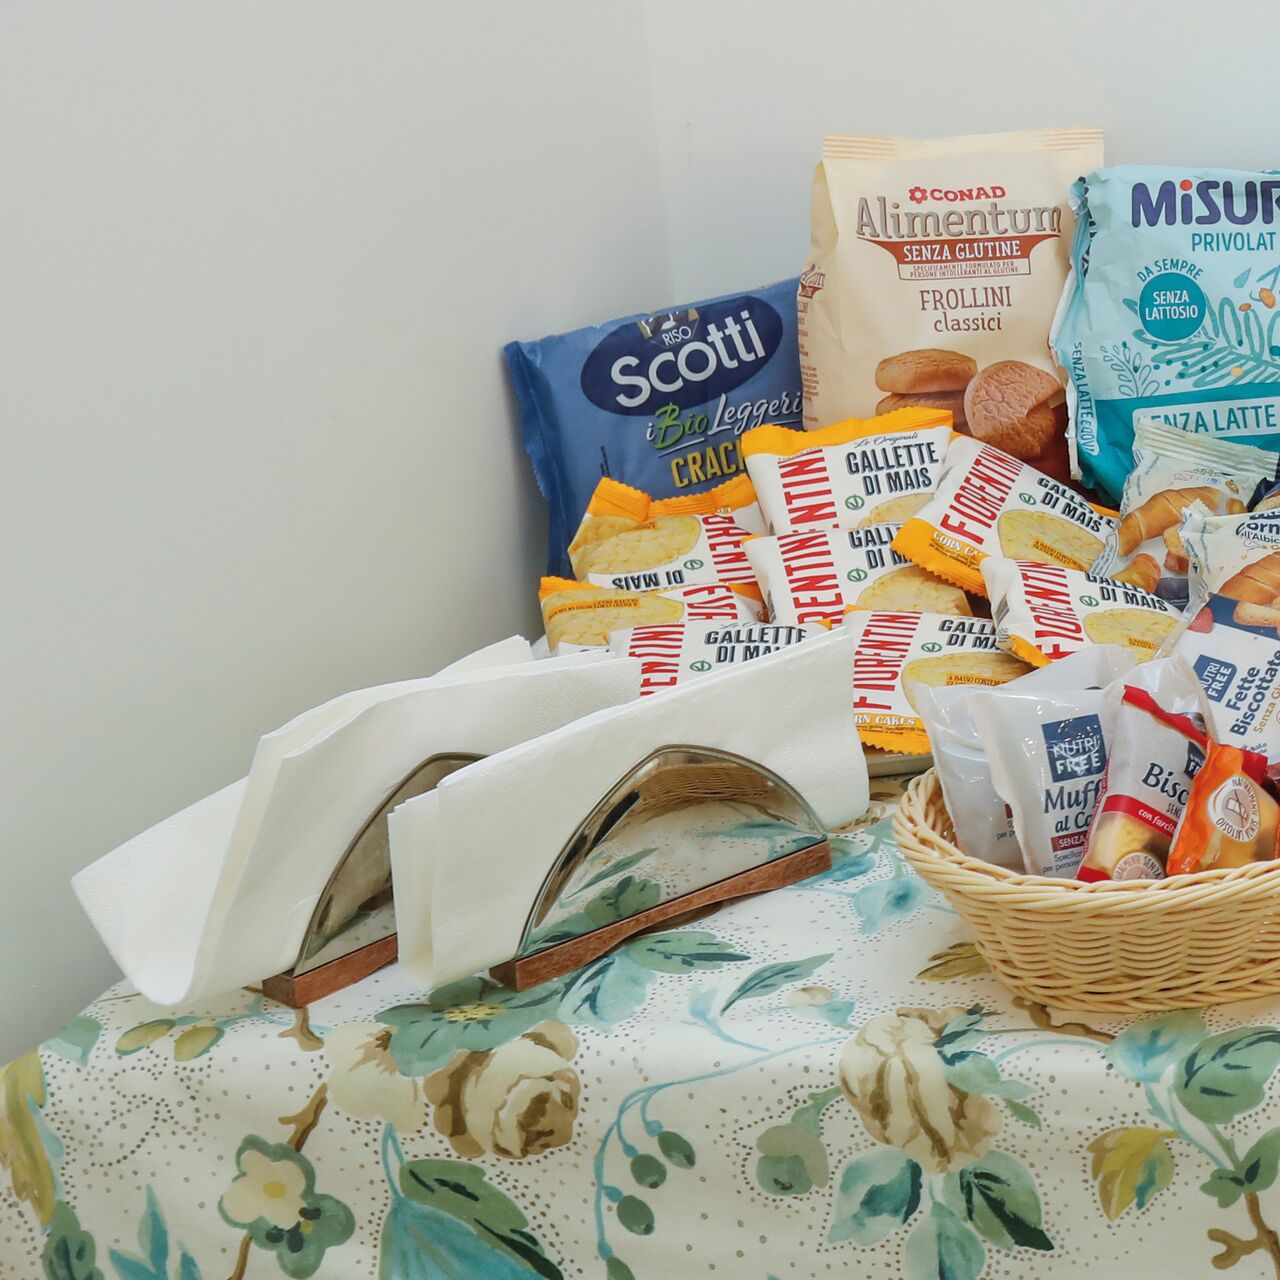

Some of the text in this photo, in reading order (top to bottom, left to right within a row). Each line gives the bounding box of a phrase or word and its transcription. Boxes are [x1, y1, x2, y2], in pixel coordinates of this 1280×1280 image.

[930, 186, 1007, 202] CONAD
[855, 196, 1062, 239] Alimentum
[903, 240, 1021, 261] SENZA GLUTINE
[1191, 232, 1276, 253] PRIVOLAT
[1137, 258, 1204, 282] DA SEMPRE
[919, 286, 1012, 311] FROLLINI
[1153, 290, 1189, 305] SENZA
[934, 312, 1002, 332] classici
[1145, 305, 1198, 321] LATTOSIO
[662, 325, 692, 346] RISO
[610, 310, 766, 407] Scotti
[1072, 342, 1086, 381] SENZA
[1076, 383, 1093, 419] LATTE
[1213, 404, 1275, 432] LATTE
[845, 442, 939, 475] GALLETTE
[863, 467, 932, 496] DI MAIS
[1041, 490, 1102, 533] DI MAIS
[933, 531, 961, 551] CORN
[866, 549, 885, 569] DI
[666, 570, 686, 585] DI
[1100, 586, 1168, 612] DI MAIS
[946, 633, 966, 647] DI
[716, 645, 736, 663] DI
[1208, 667, 1232, 697] FREE
[1225, 667, 1260, 711] Fette
[876, 715, 916, 726] CAKES
[1254, 702, 1277, 733] Senza
[1052, 735, 1101, 759] NUTRI
[1056, 753, 1102, 775] FREE
[1055, 815, 1071, 833] al
[1138, 809, 1153, 822] con
[1059, 835, 1085, 848] SENZA
